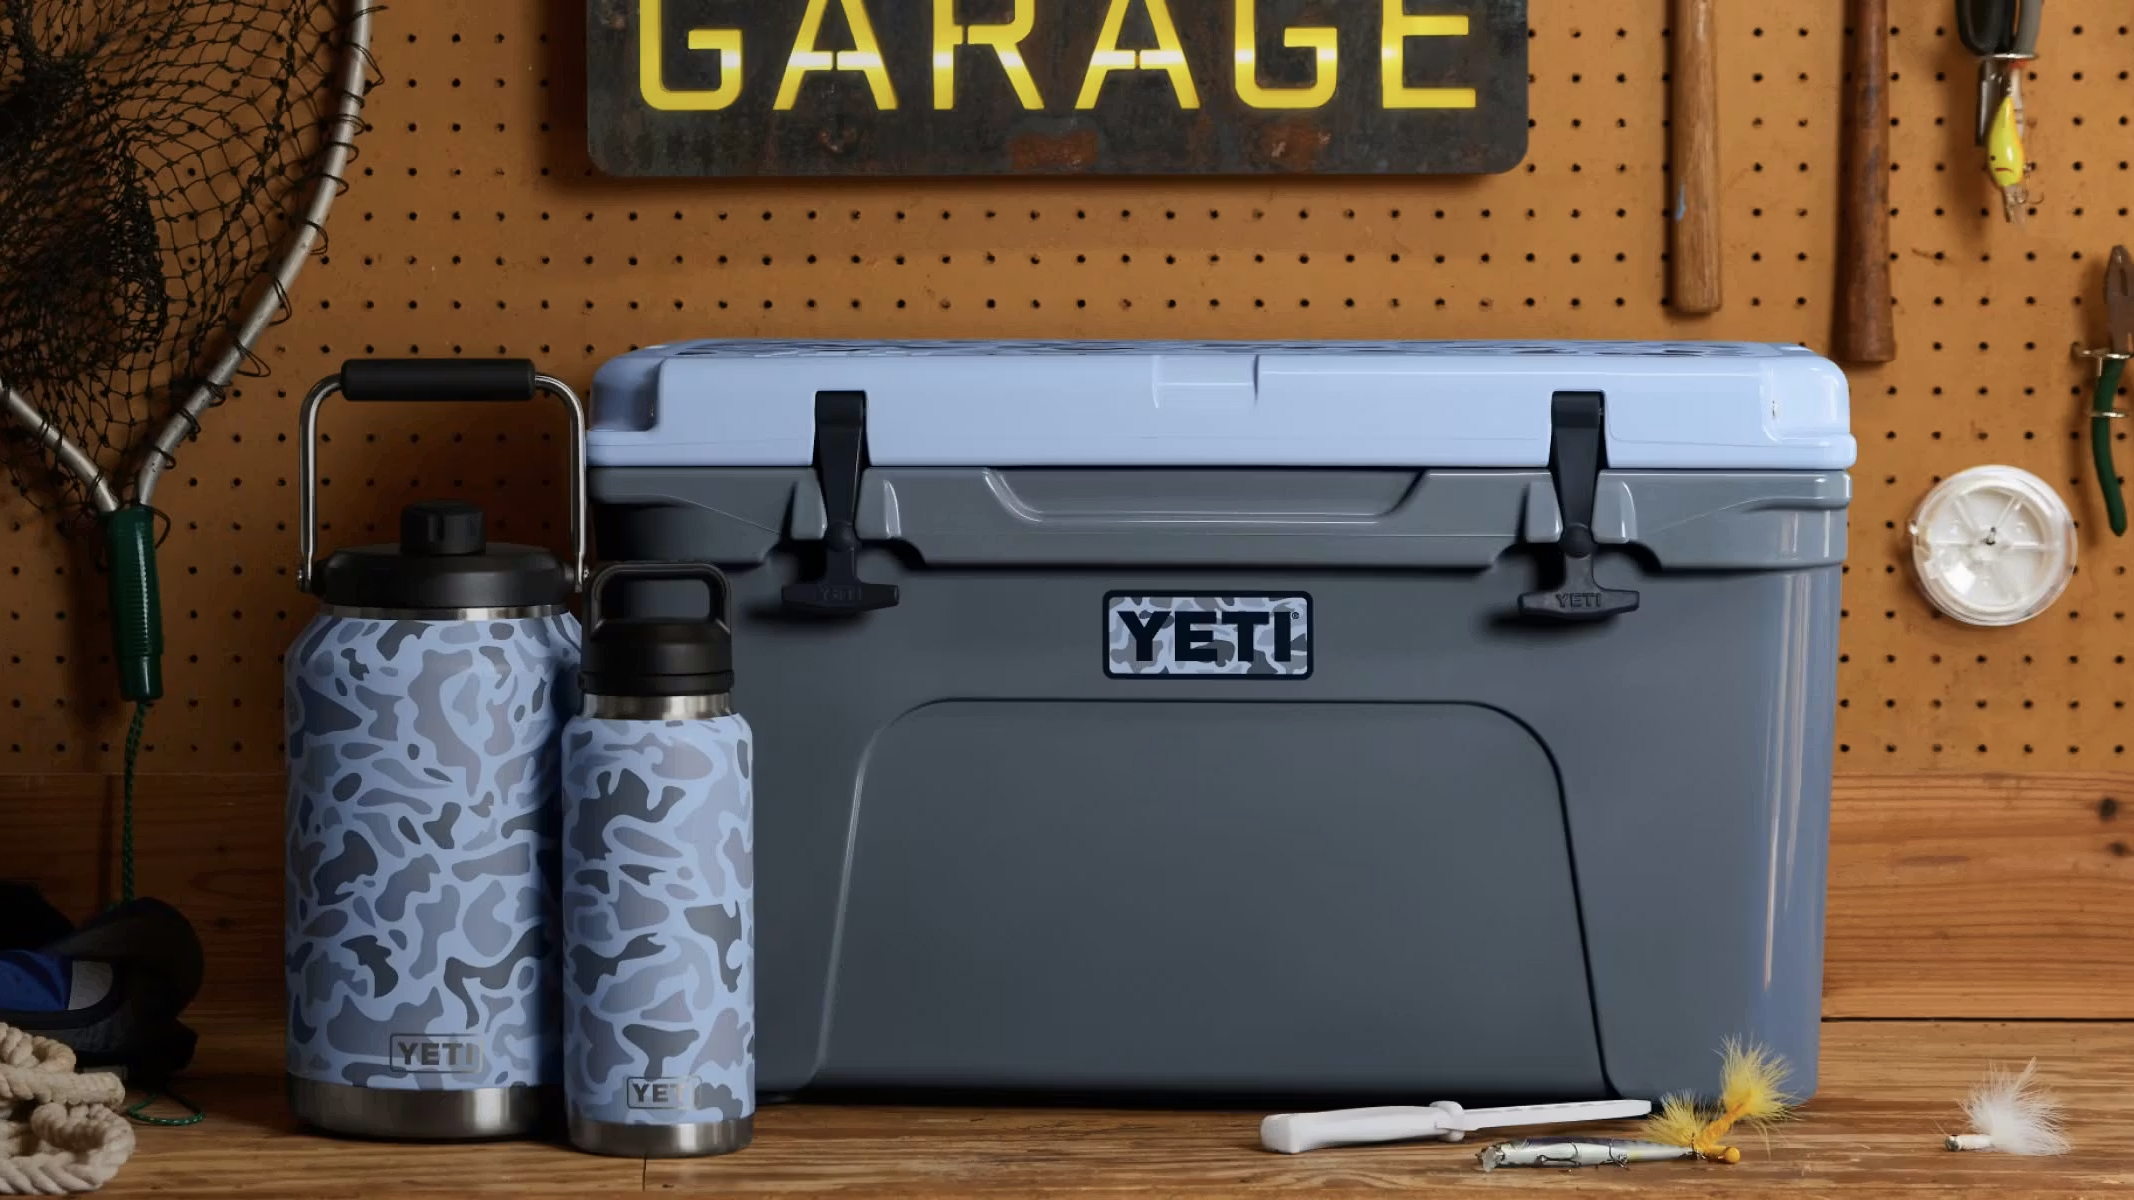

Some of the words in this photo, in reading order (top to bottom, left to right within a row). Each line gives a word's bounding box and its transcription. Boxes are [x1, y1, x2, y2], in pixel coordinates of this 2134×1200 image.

[640, 0, 1477, 110] GARAGE
[1556, 592, 1601, 608] YETI
[398, 1042, 473, 1065] YETI
[632, 1083, 692, 1103] YET
